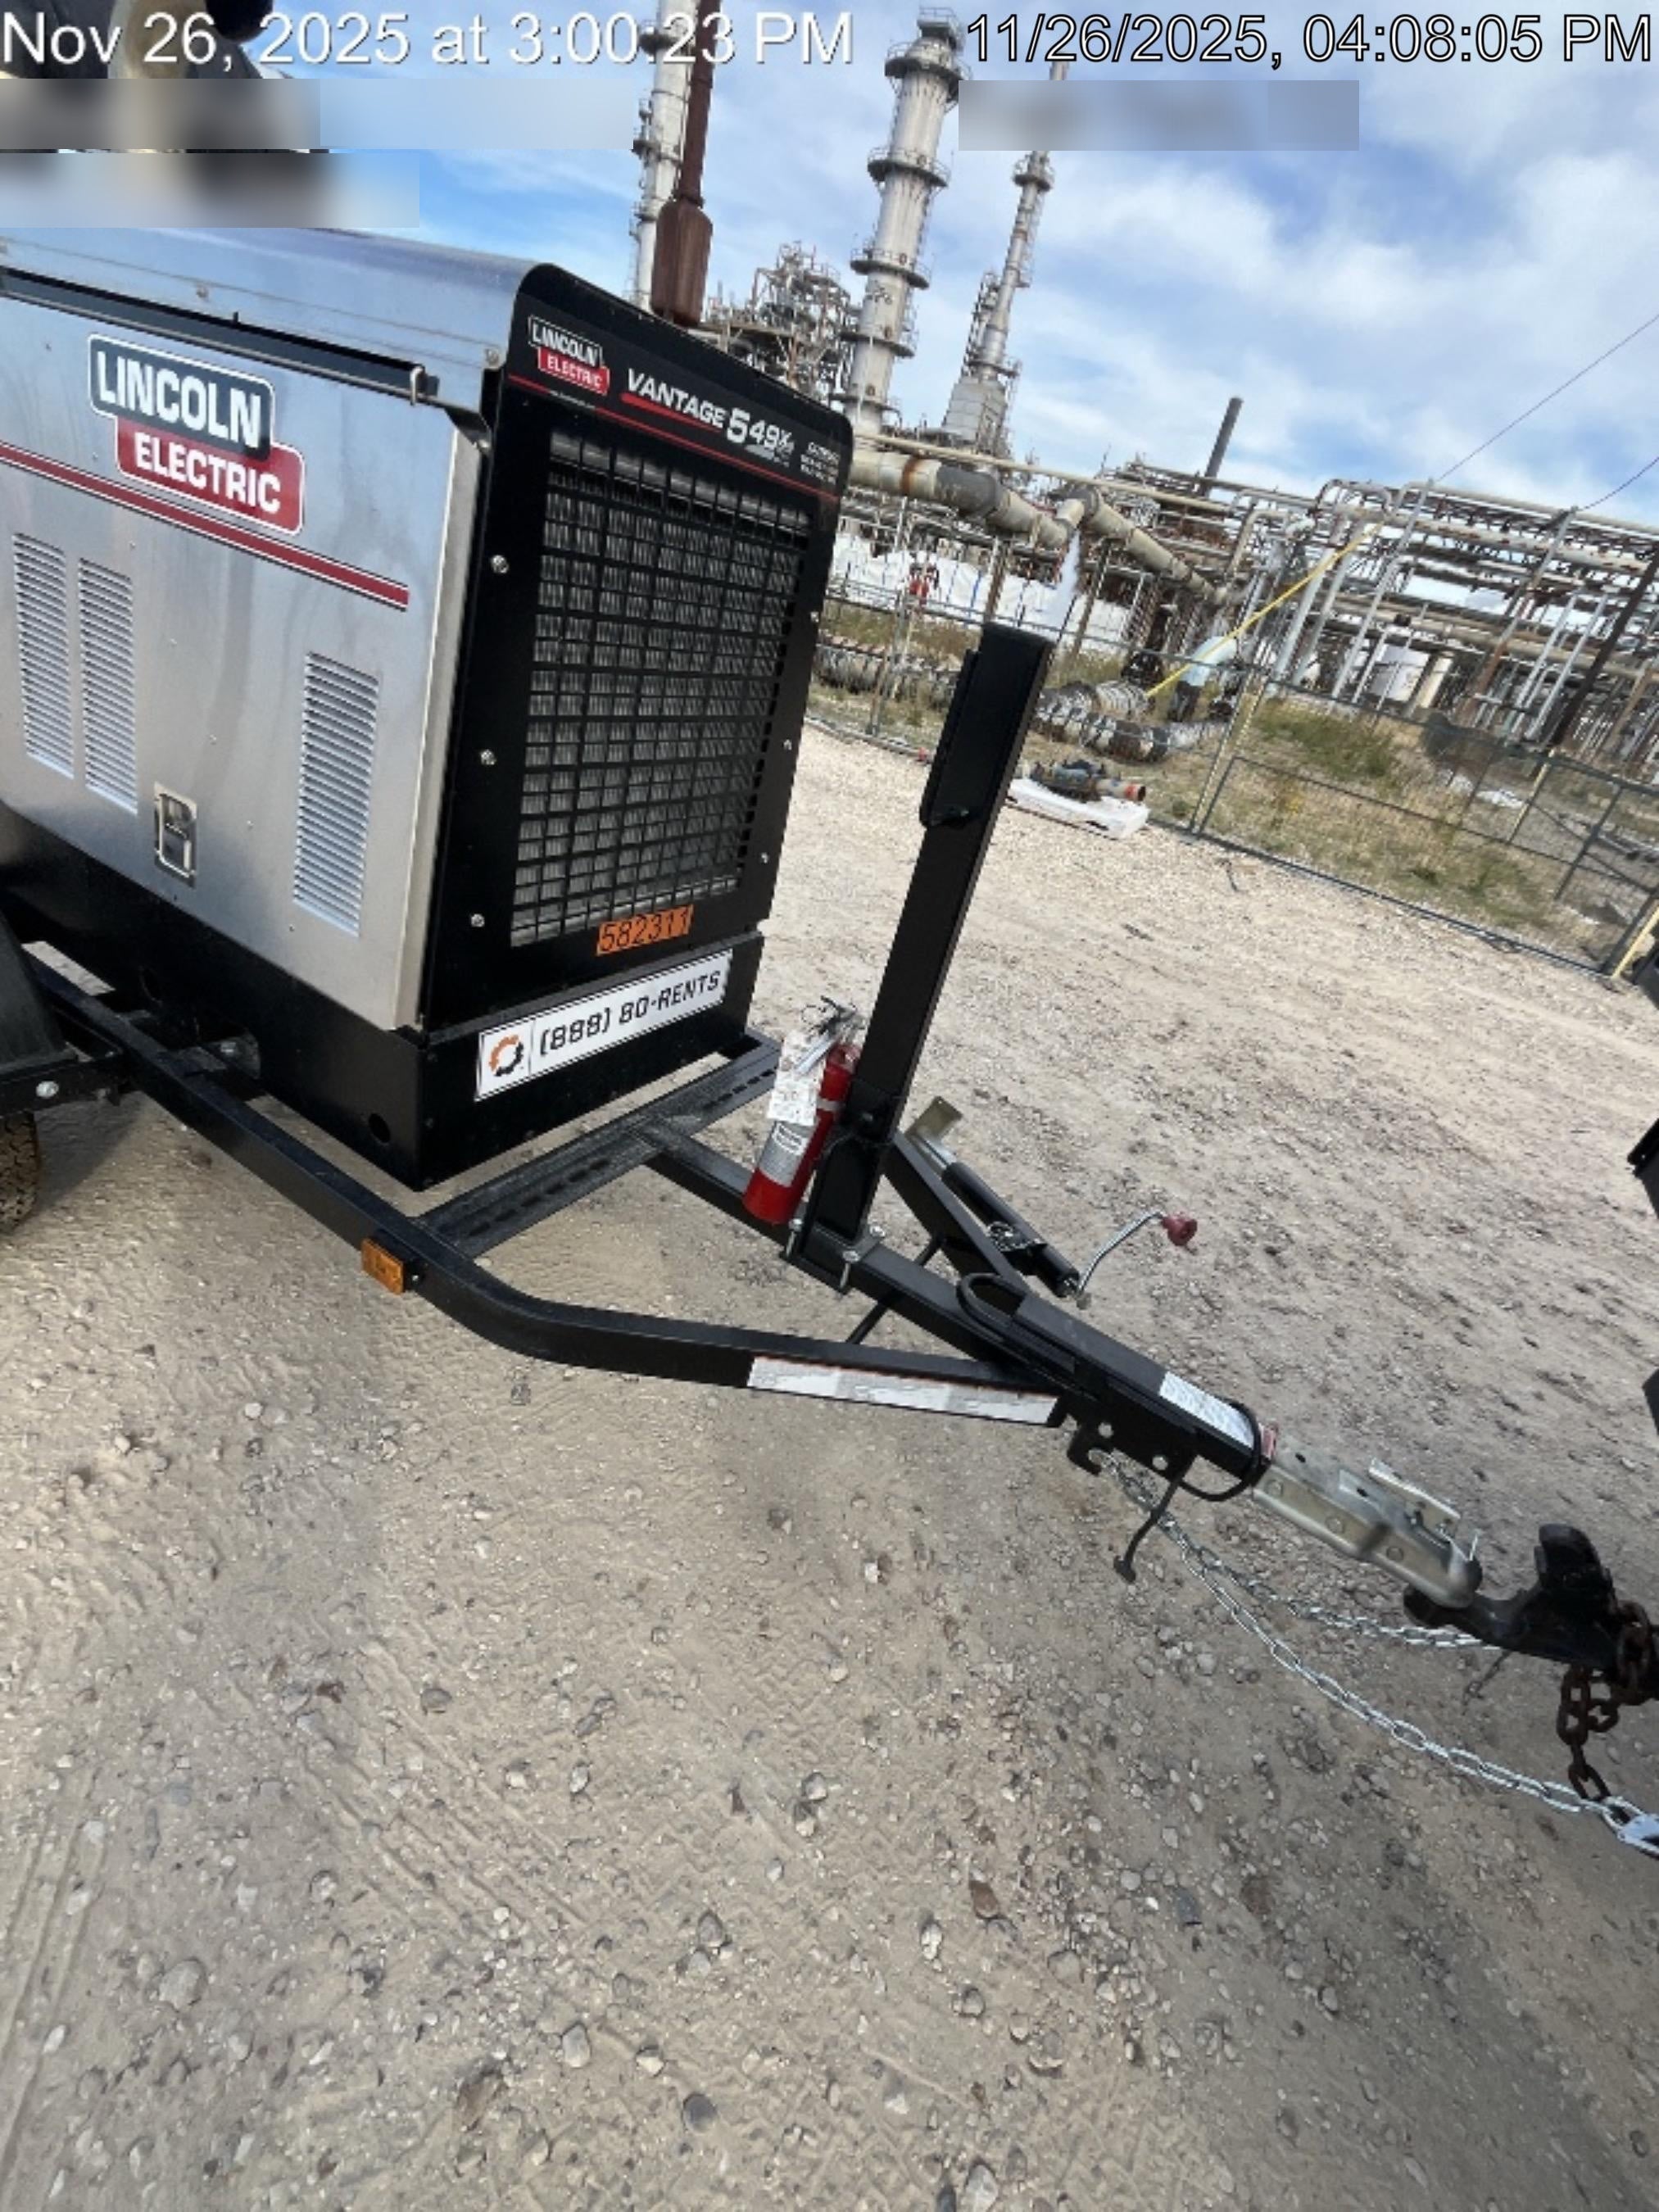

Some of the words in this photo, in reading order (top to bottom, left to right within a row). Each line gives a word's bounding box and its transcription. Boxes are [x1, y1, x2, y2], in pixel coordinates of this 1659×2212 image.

[533, 323, 599, 367] LINCOLN
[547, 355, 602, 388] ELECTRIC
[97, 351, 262, 449] LINCOLN
[628, 367, 727, 429] VANTAGE
[134, 432, 281, 514] ELECTRIC
[601, 906, 690, 951] 582311
[539, 1007, 611, 1056] (888)
